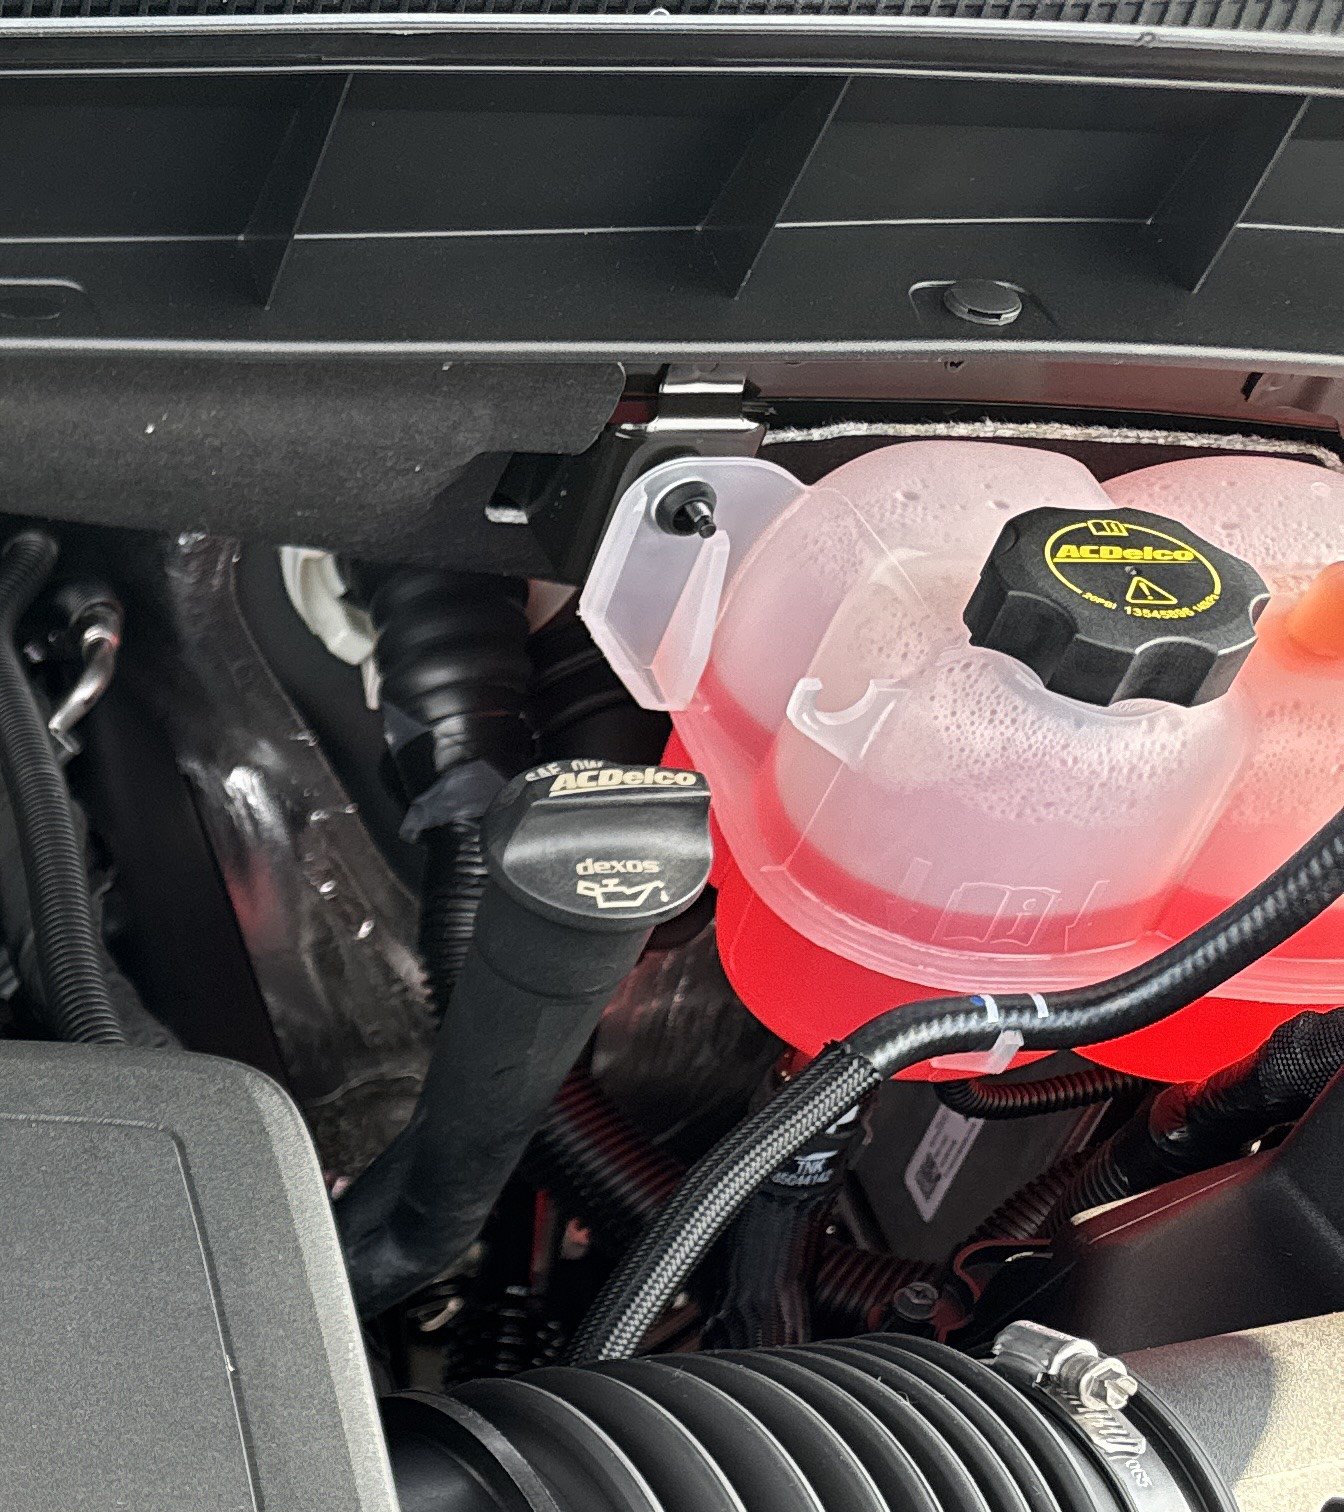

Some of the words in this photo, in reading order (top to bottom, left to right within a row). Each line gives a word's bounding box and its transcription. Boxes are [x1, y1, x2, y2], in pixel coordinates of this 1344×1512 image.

[1055, 544, 1195, 562] ACDelco
[549, 767, 697, 792] ACDelco
[575, 857, 660, 876] dexos
